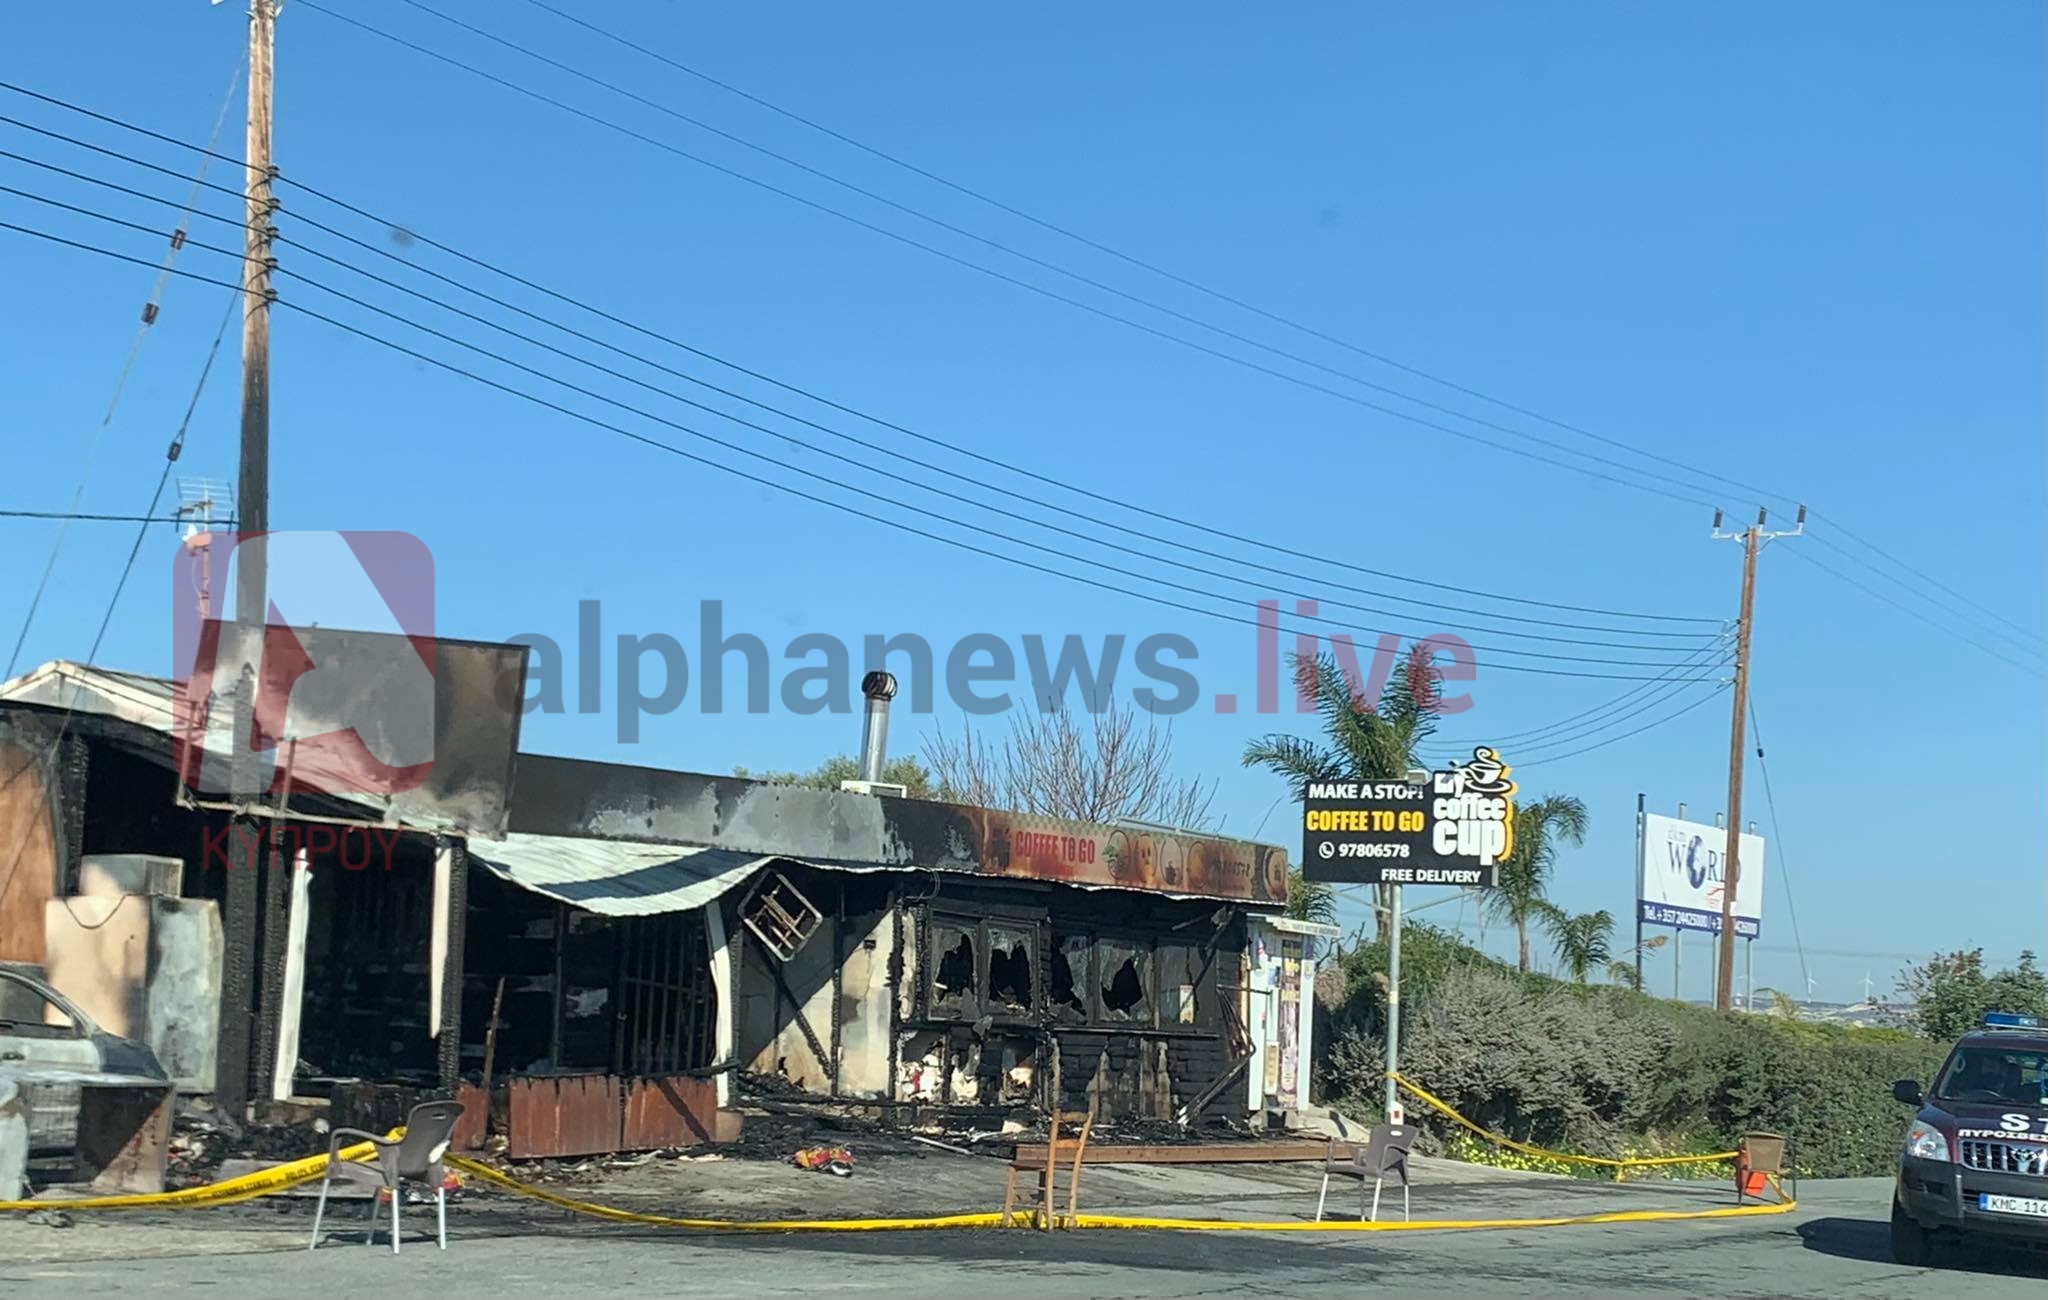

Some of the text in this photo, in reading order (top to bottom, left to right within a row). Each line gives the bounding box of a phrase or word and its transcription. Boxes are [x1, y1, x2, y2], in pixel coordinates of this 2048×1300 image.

[1308, 783, 1424, 800] MAKE A STOP!
[1433, 792, 1507, 820] coffee
[1306, 810, 1424, 832] COFFEE TO GO
[1061, 835, 1076, 862] TO
[1079, 838, 1095, 865] GO
[1339, 843, 1411, 858] 97806578
[1432, 819, 1506, 866] cup
[1667, 835, 1741, 889] WORL
[1381, 868, 1482, 884] FREE DELIVERY
[1991, 1197, 2016, 1211] KMC
